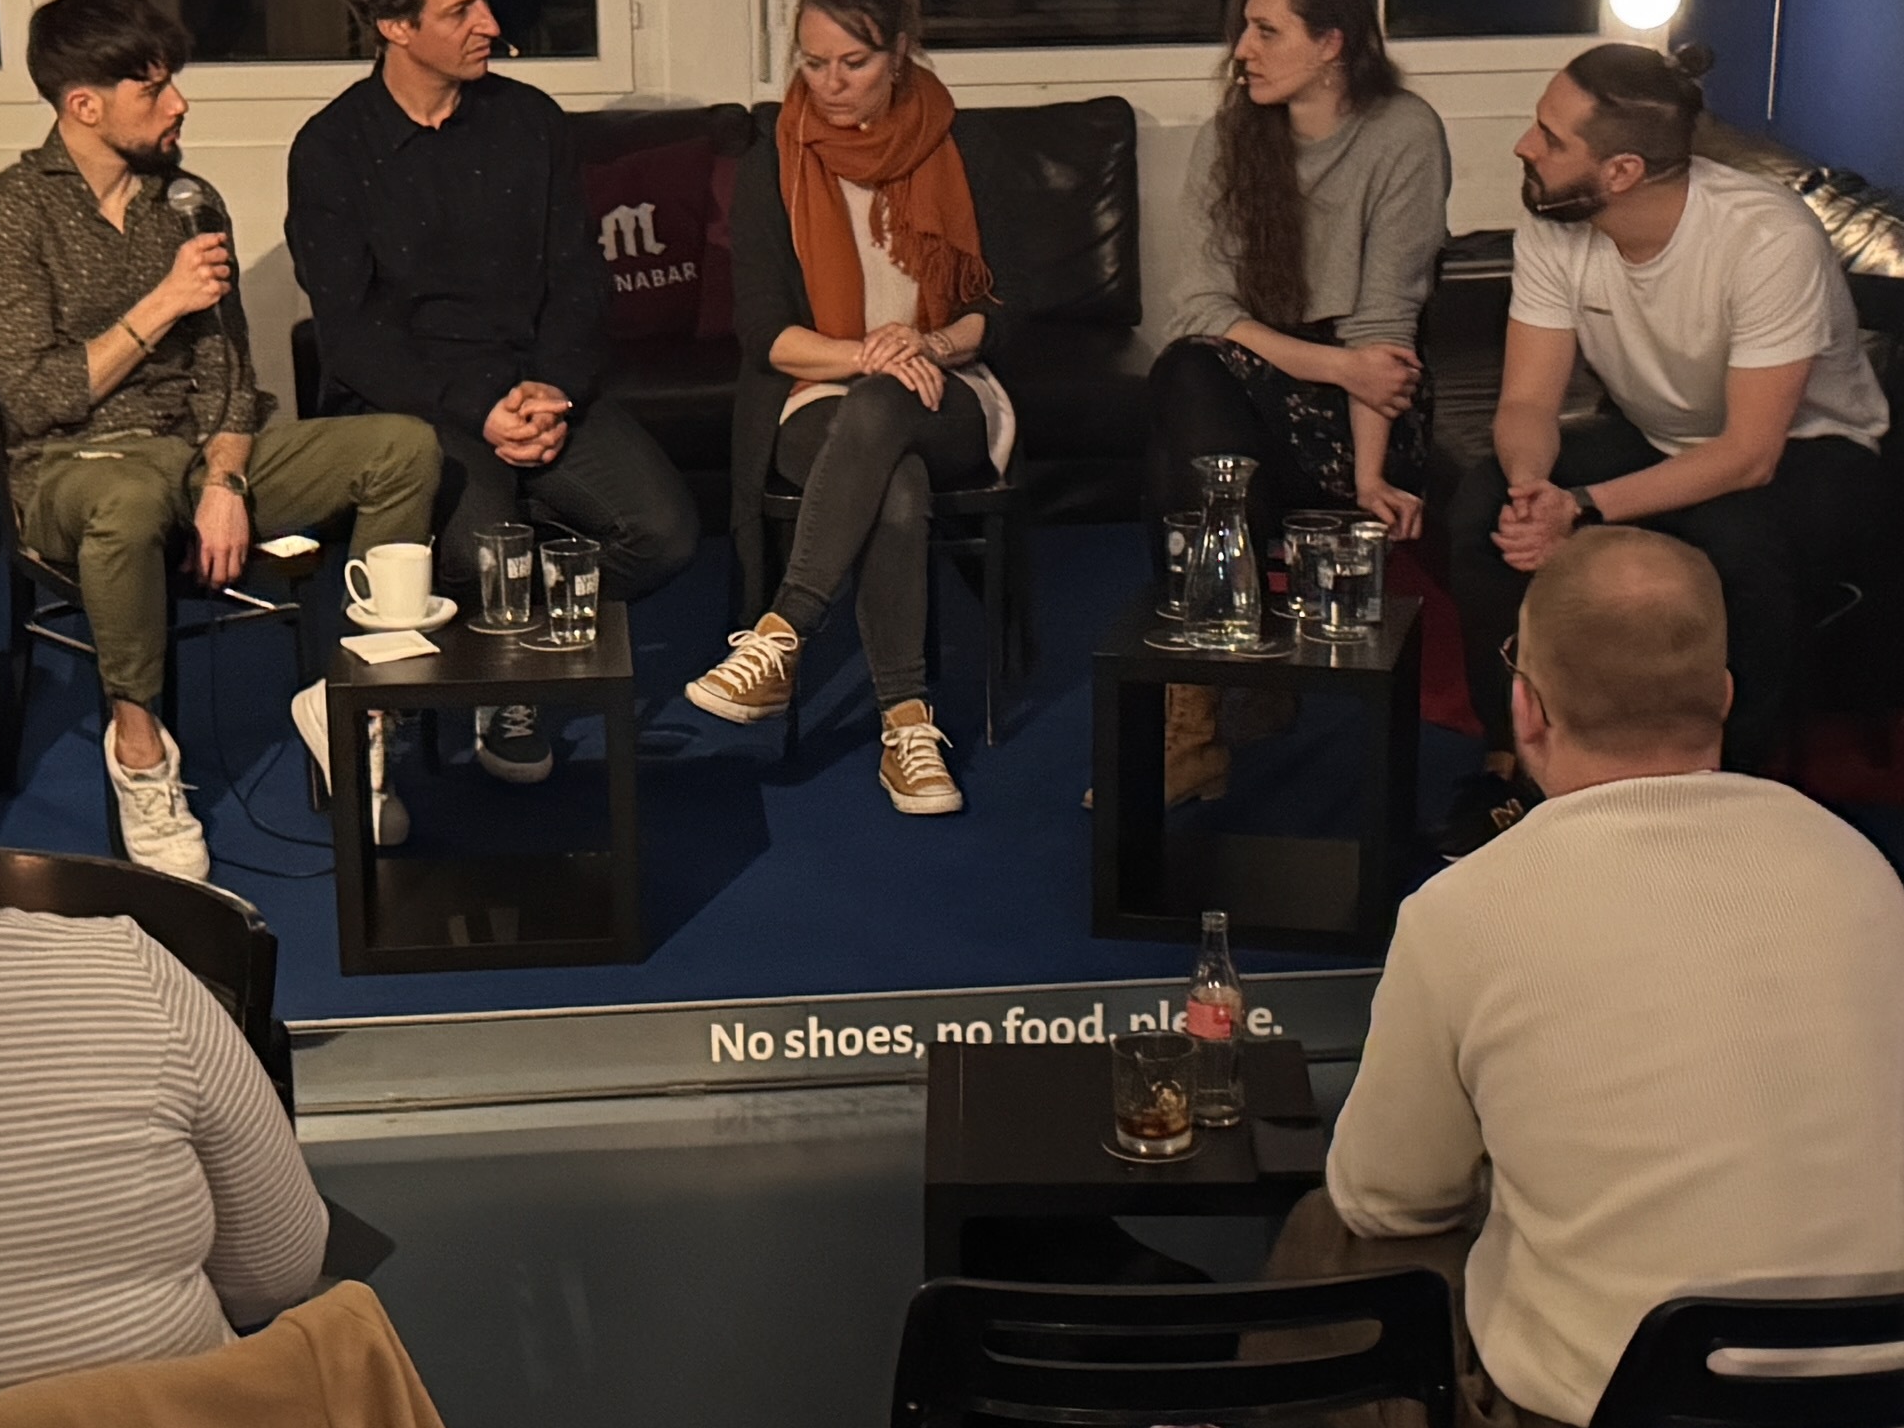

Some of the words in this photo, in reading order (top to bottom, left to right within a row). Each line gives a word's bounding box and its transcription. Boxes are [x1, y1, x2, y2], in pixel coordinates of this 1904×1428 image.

[613, 261, 699, 294] NABAR
[710, 1023, 775, 1063] No
[783, 1015, 927, 1061] shoes,
[937, 1019, 994, 1044] no
